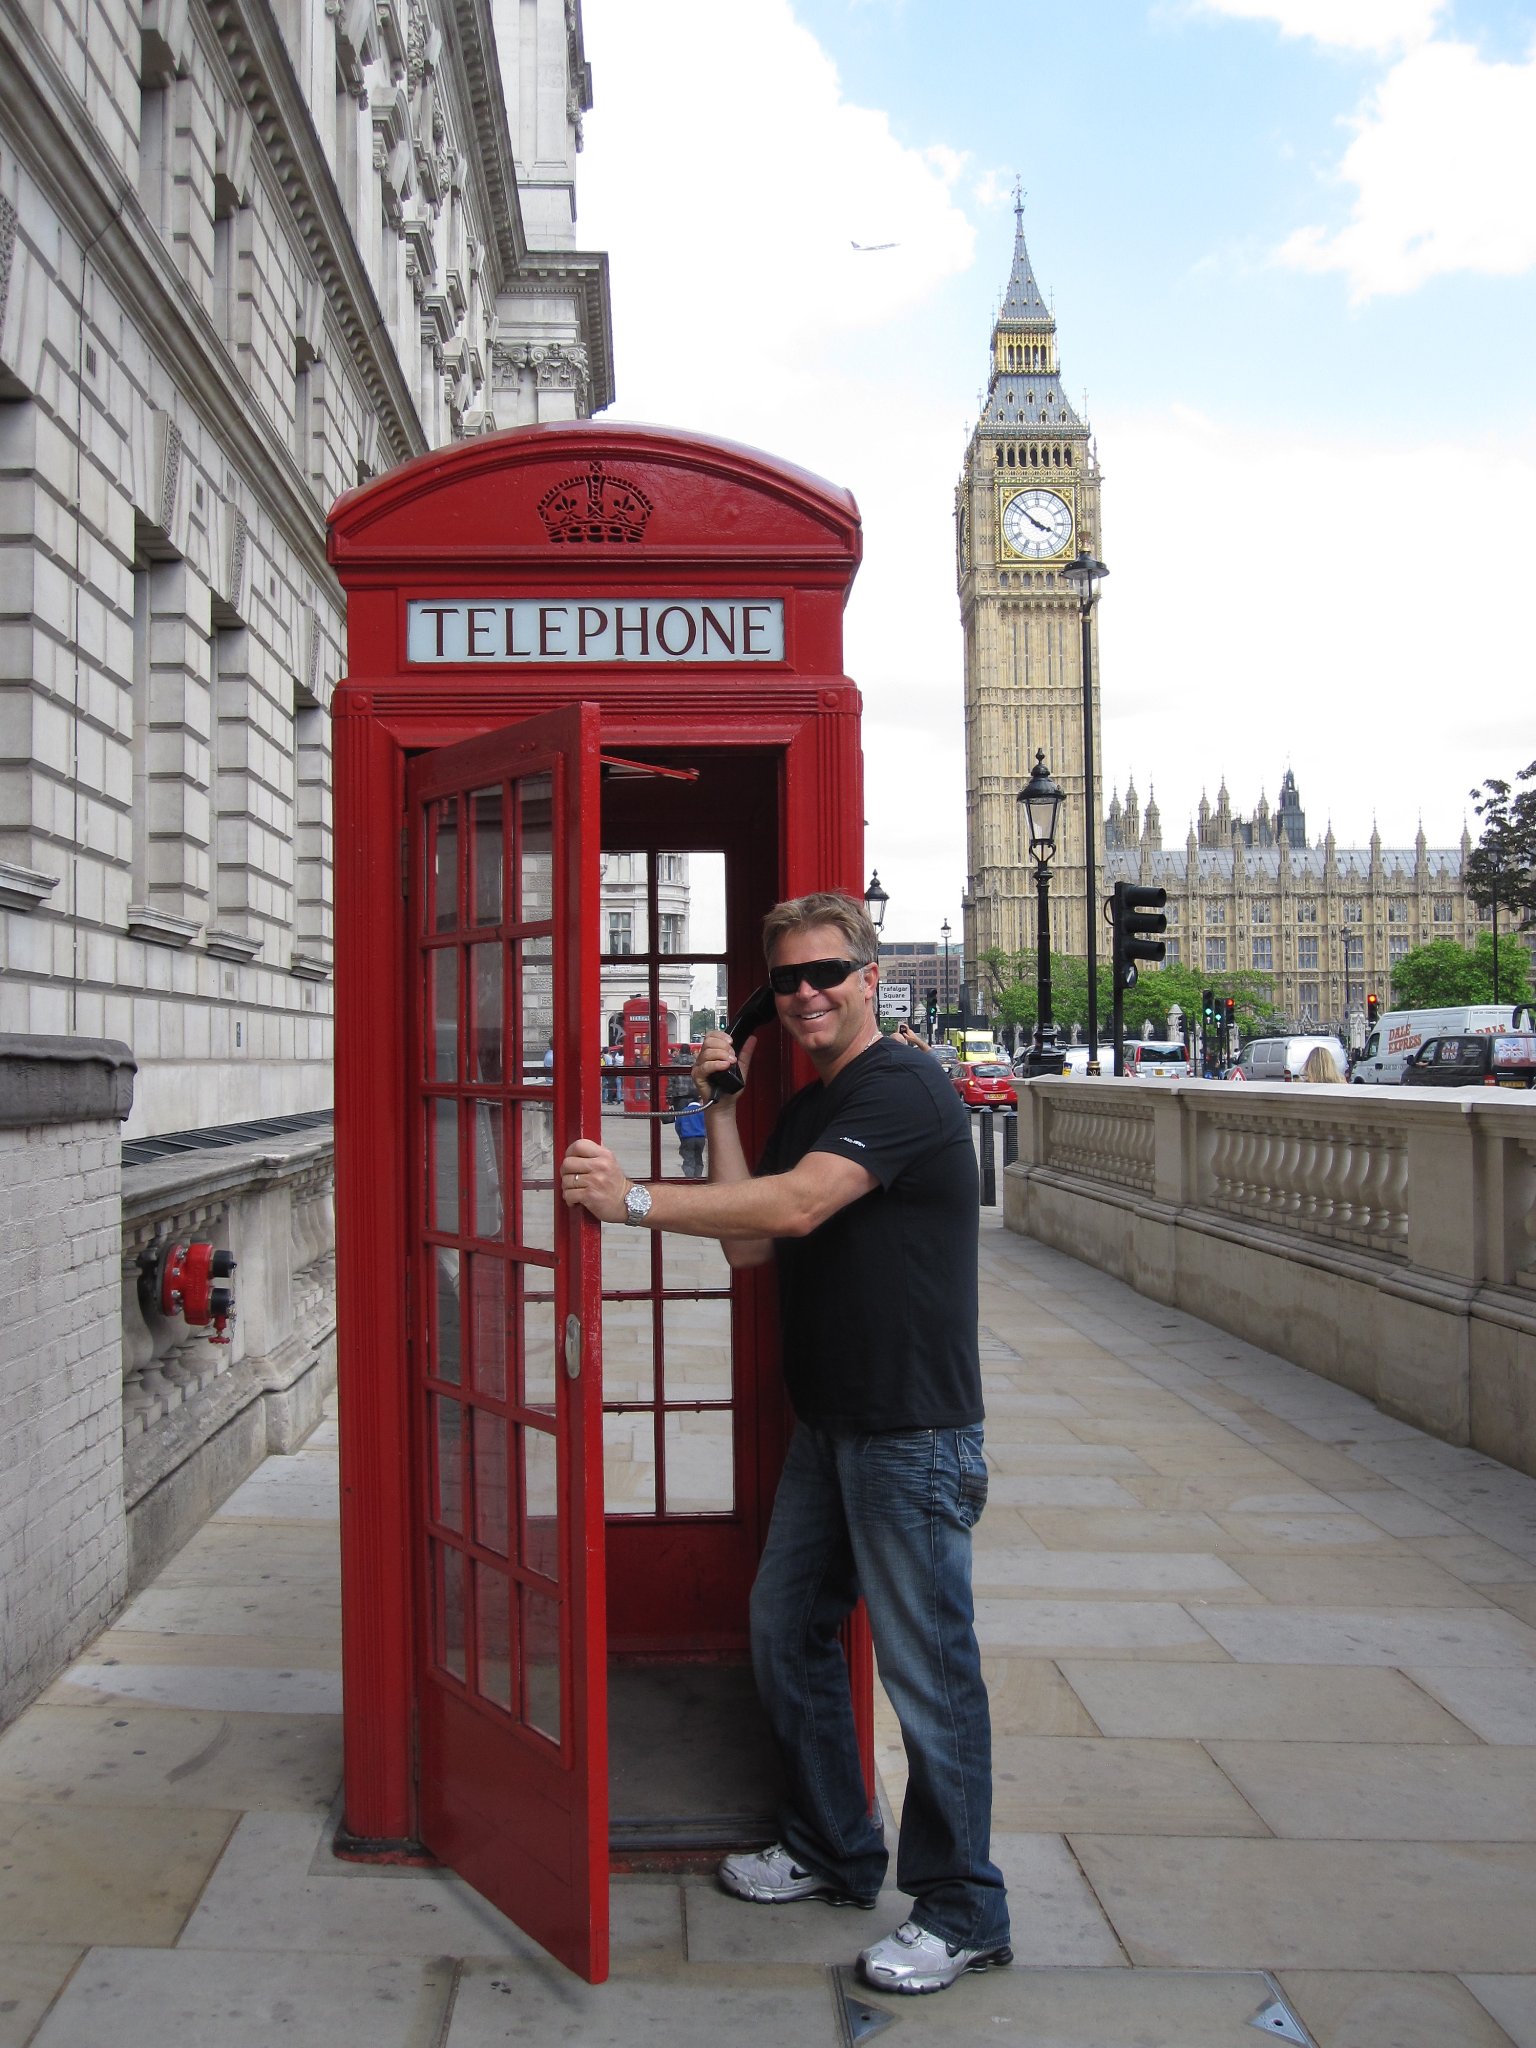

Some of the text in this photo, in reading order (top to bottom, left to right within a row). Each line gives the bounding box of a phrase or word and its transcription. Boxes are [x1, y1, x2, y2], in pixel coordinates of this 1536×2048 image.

[420, 605, 772, 657] TELEPHONE
[1389, 1023, 1411, 1041] DALE
[1388, 1034, 1422, 1054] EXPRESS
